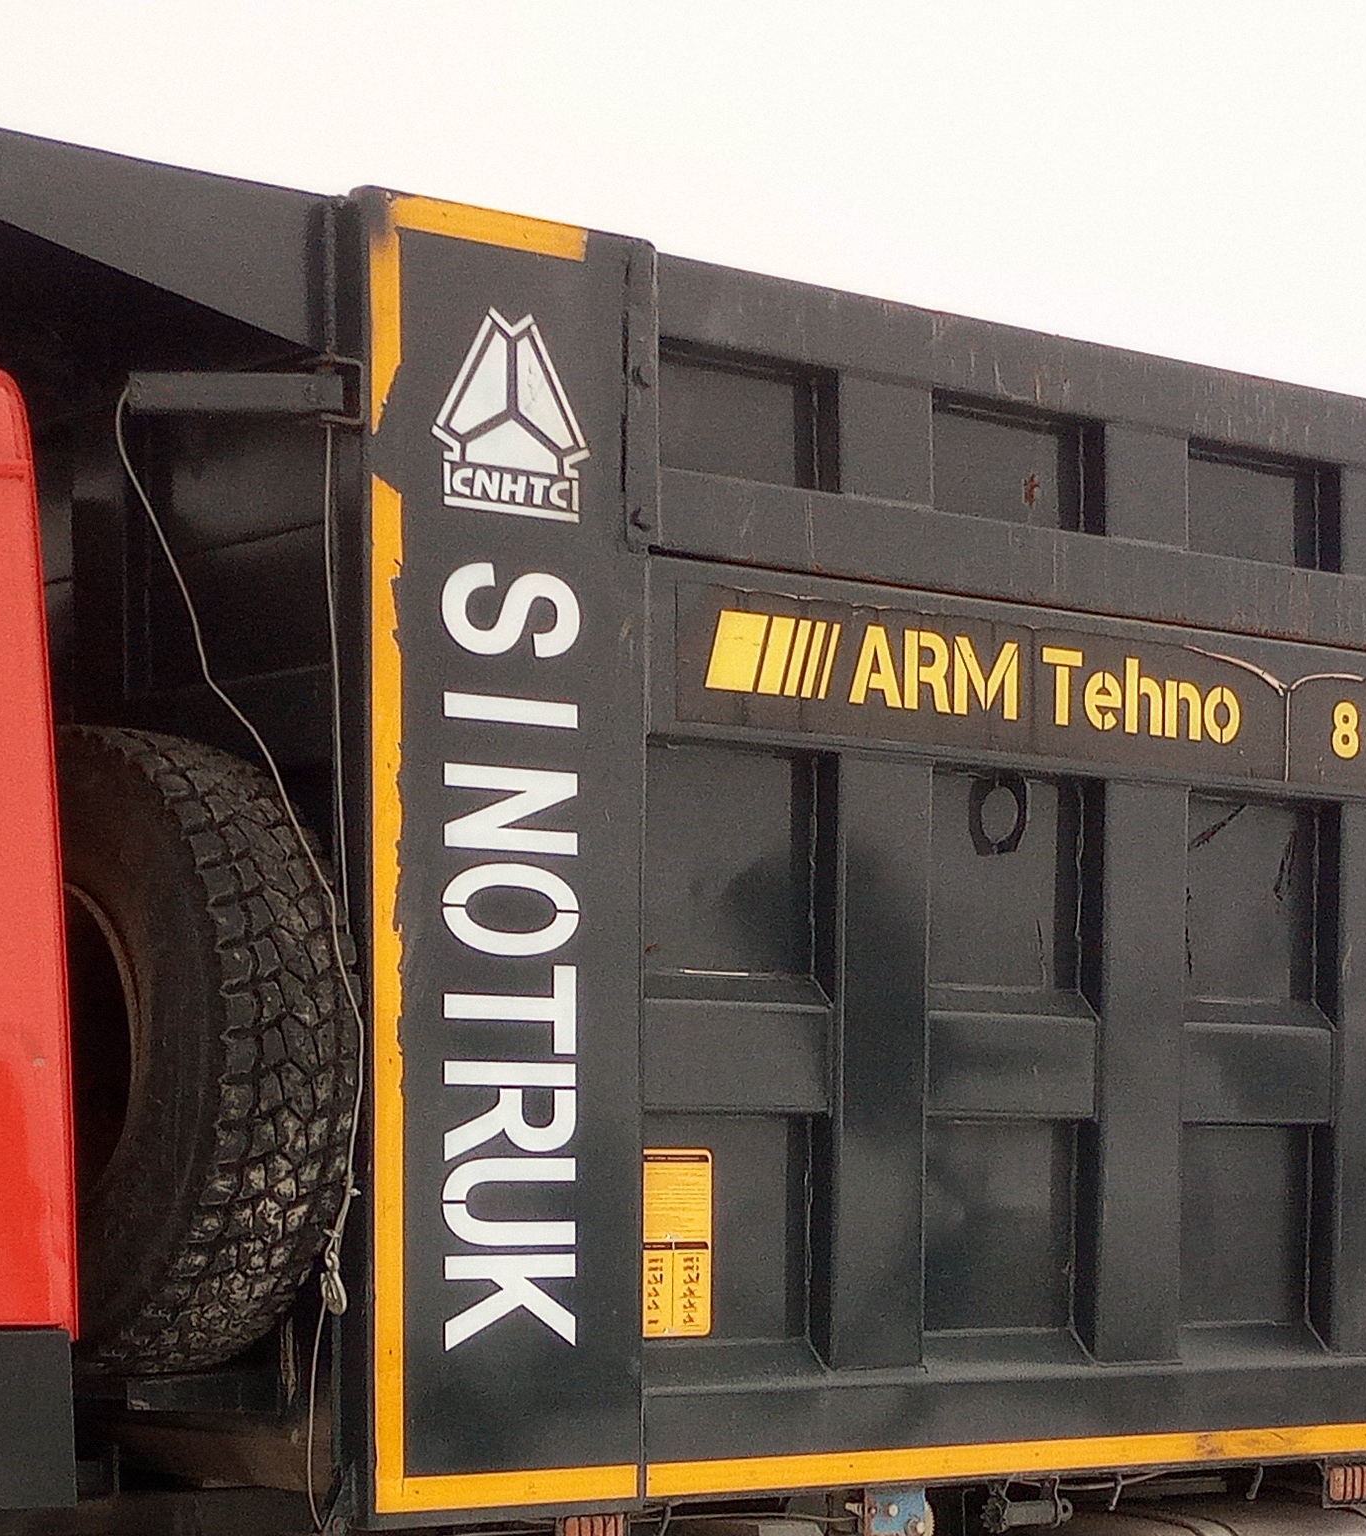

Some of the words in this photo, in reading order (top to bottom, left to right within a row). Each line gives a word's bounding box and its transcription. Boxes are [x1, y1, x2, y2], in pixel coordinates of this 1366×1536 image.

[451, 467, 571, 511] CNHTC
[848, 624, 1020, 722] ARM
[1042, 646, 1242, 745] Tehno
[1331, 701, 1361, 760] 8
[440, 561, 581, 1352] SINOTRUK
